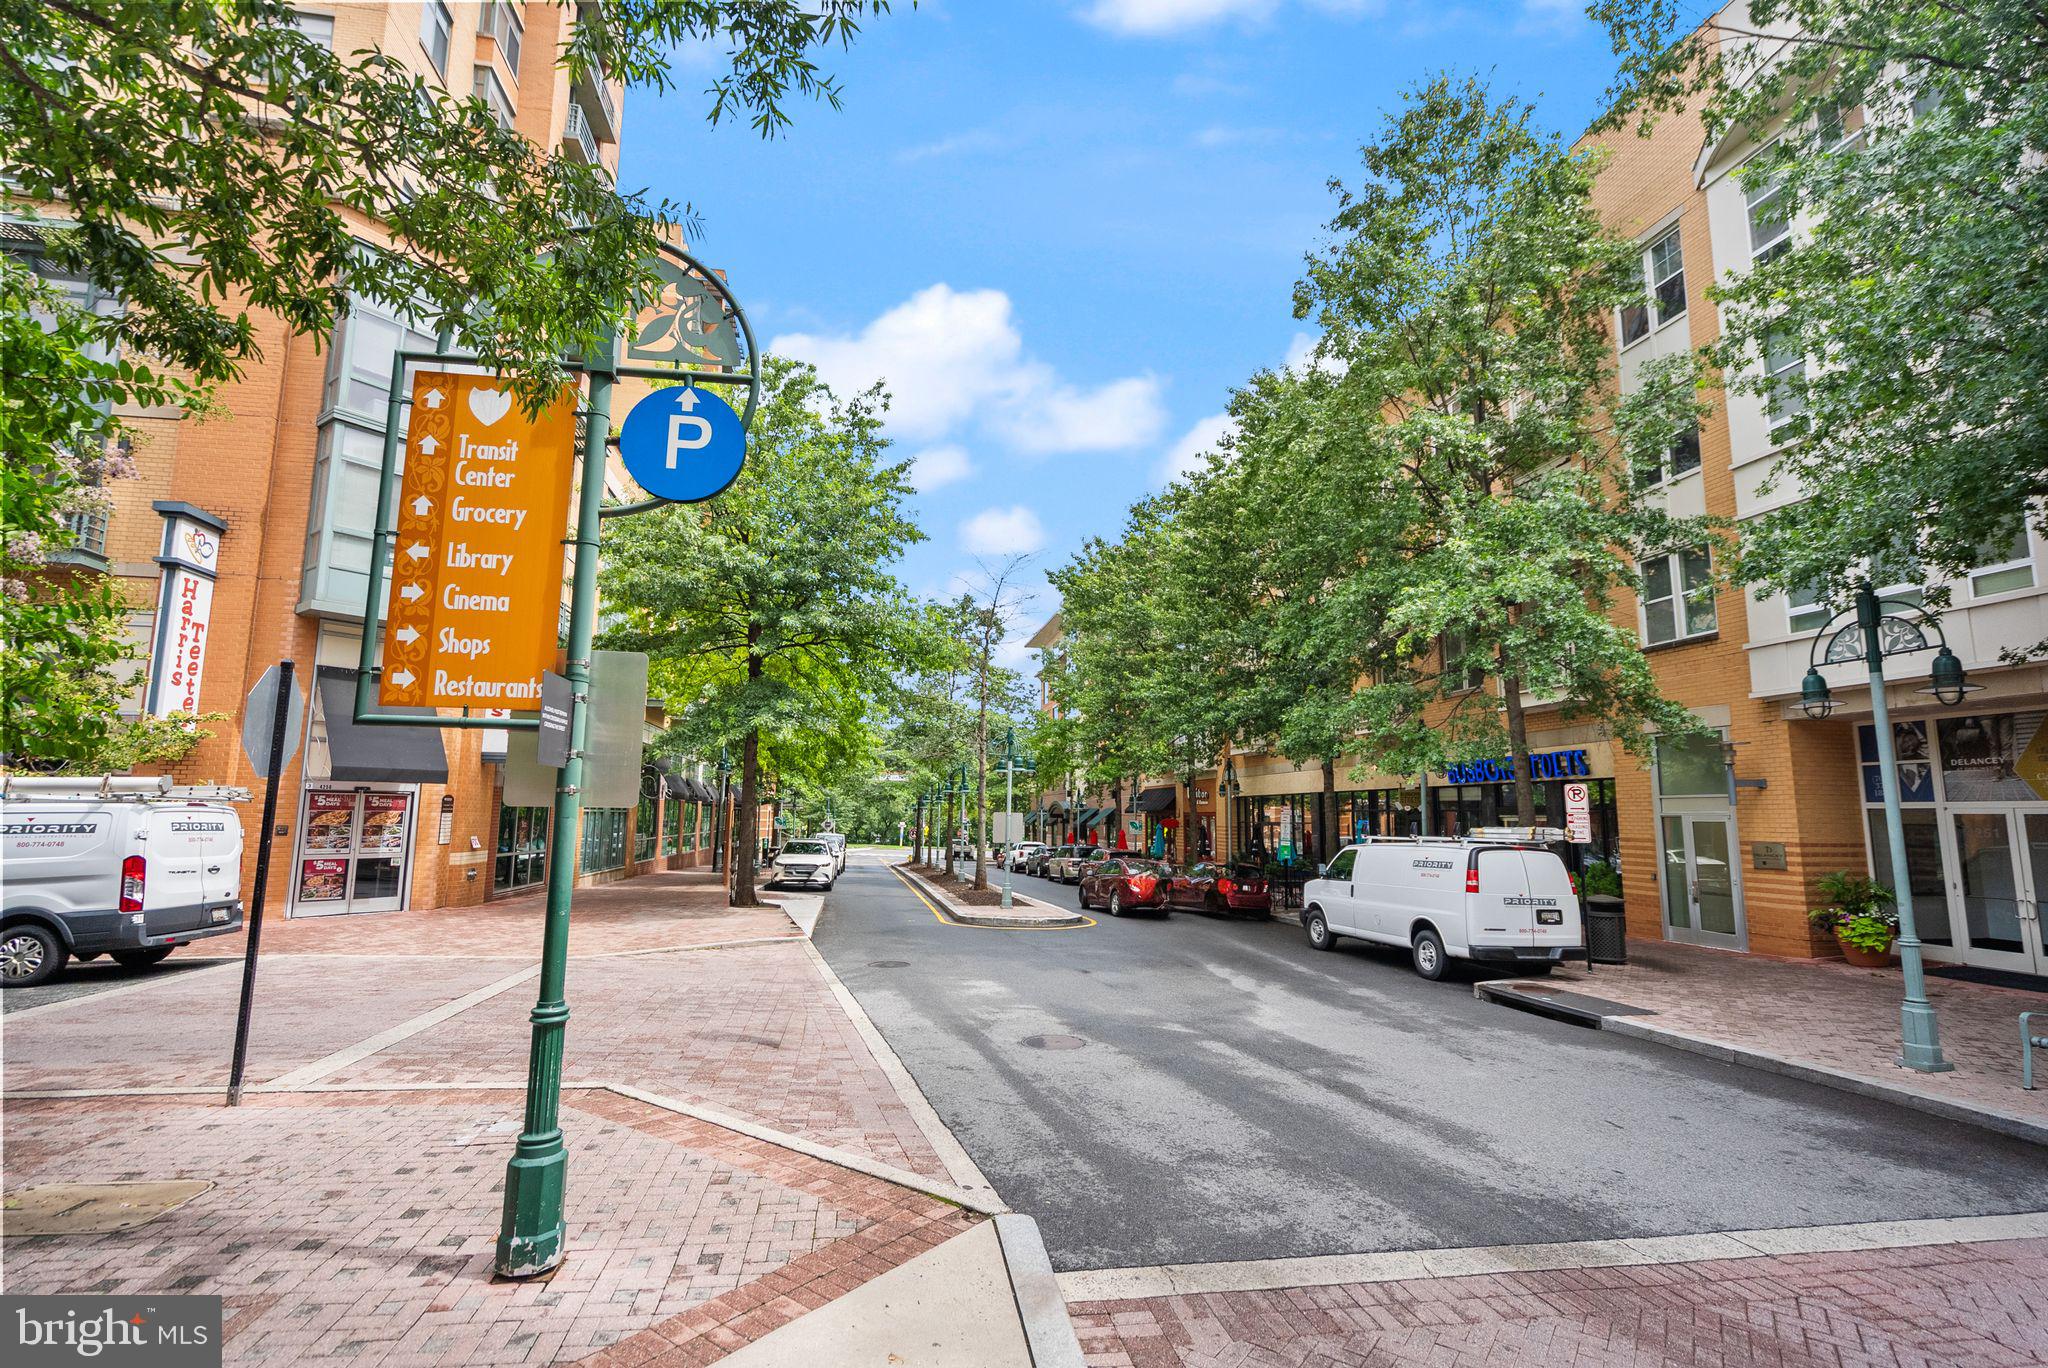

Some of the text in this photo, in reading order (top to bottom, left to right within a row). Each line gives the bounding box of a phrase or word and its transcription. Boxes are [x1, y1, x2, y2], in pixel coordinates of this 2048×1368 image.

[459, 433, 519, 462] Transit
[665, 414, 713, 470] P
[455, 460, 516, 488] Center
[451, 495, 528, 531] Grocery
[446, 541, 514, 576] Library
[443, 583, 511, 612] Cinema
[171, 577, 200, 687] Harris
[438, 626, 491, 660] Shops
[181, 621, 205, 728] Teete
[433, 669, 543, 699] Restaurants
[1951, 757, 2005, 766] DELANCEY
[171, 823, 225, 831] PRIORITY
[1413, 860, 1453, 869] PRIORITY
[1504, 898, 1556, 906] PRIORITY
